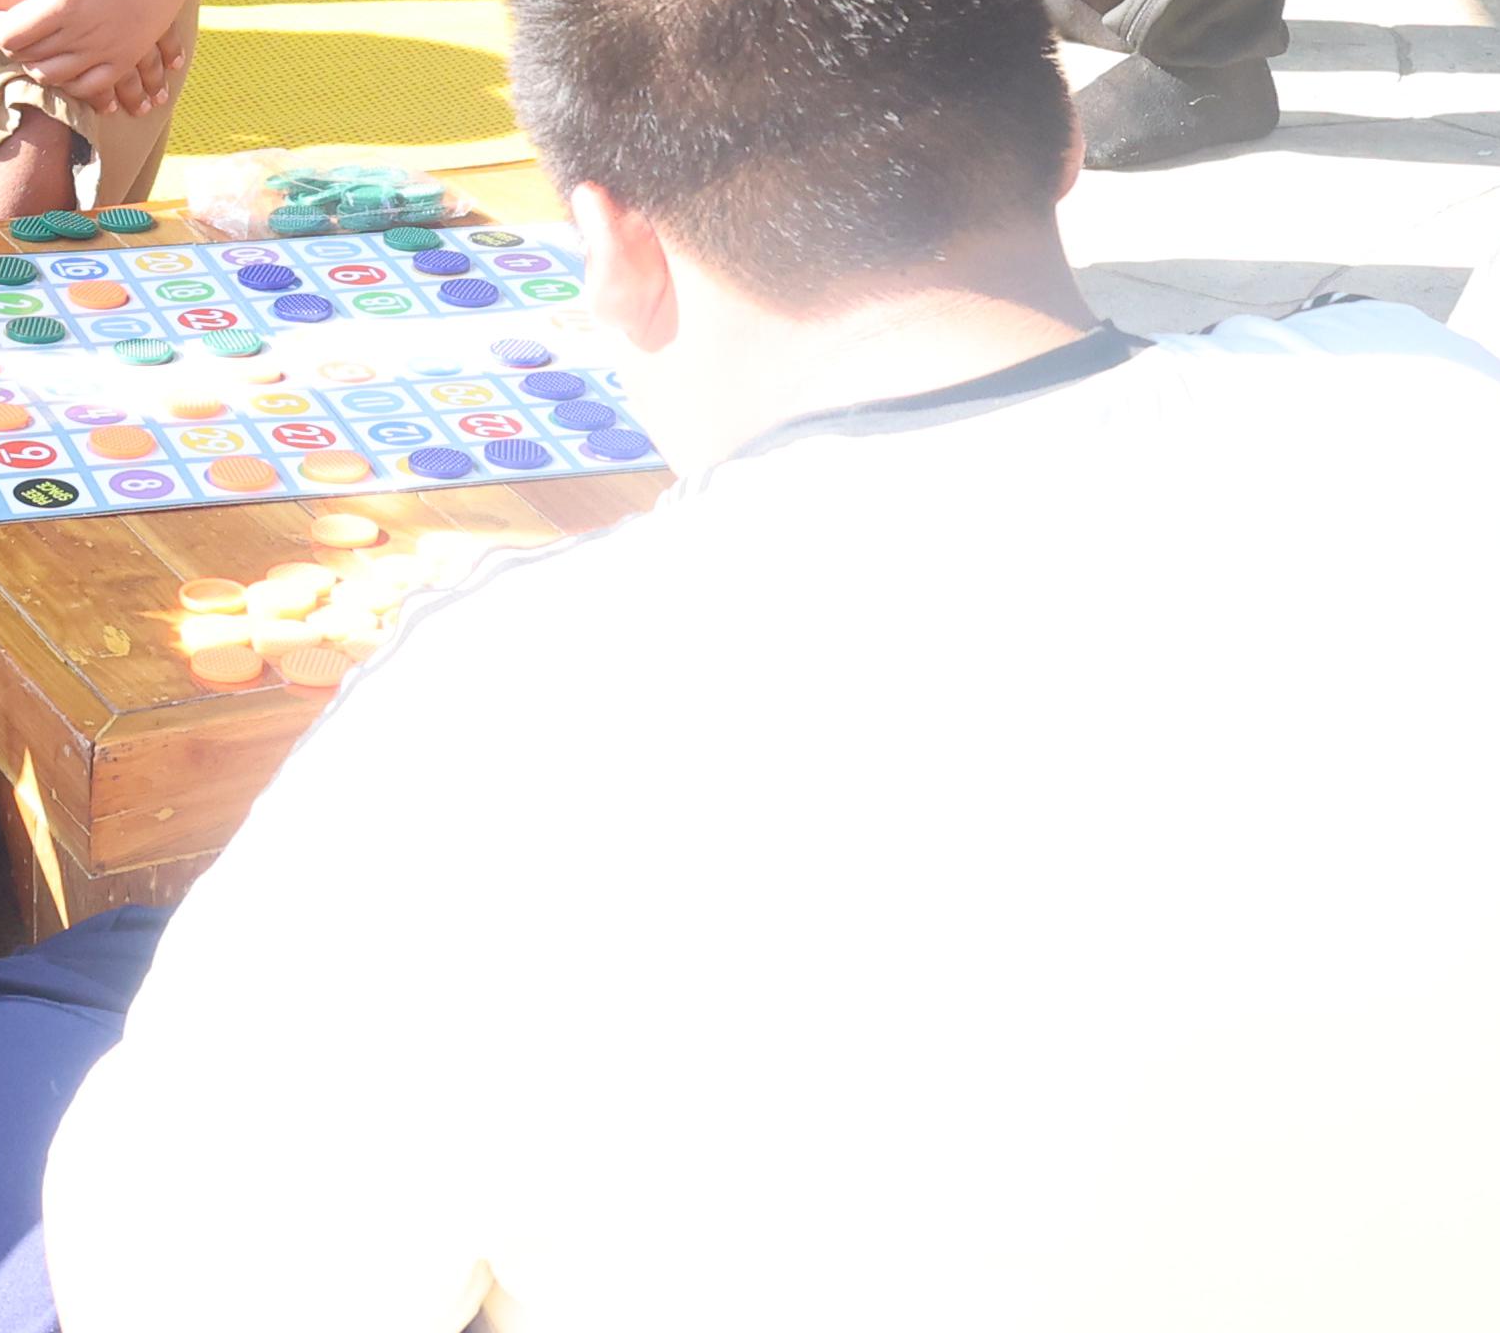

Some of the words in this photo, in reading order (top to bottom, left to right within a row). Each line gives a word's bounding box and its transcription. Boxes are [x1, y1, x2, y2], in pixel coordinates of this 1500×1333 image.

[55, 259, 102, 277] 16
[142, 253, 179, 272] 20
[161, 282, 207, 301] 18
[379, 423, 421, 443] 12
[467, 414, 513, 437] 22
[285, 424, 328, 447] 27
[120, 477, 164, 491] 8
